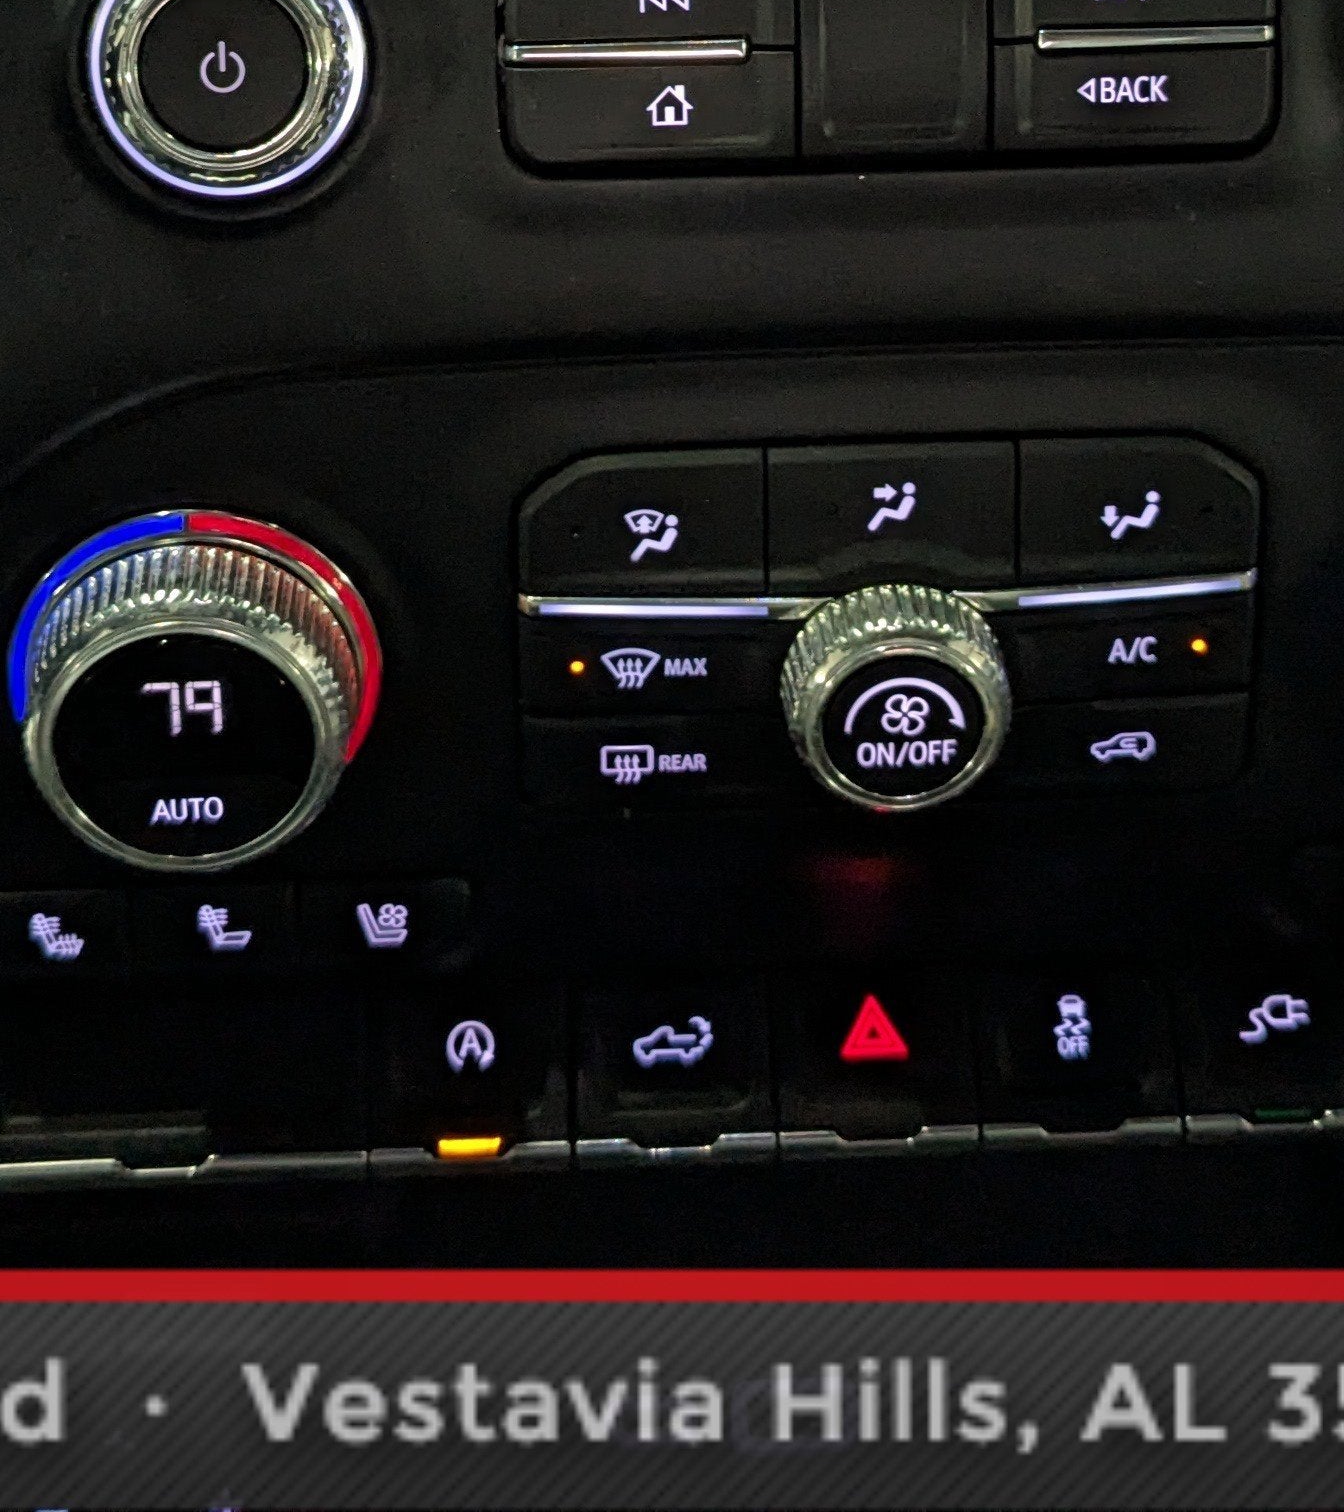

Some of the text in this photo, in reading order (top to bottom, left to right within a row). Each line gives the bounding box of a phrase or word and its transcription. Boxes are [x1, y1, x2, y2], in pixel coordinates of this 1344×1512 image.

[1098, 73, 1170, 105] BACK
[1106, 634, 1158, 664] A/C
[663, 655, 709, 678] MAX
[142, 679, 224, 736] 79
[657, 751, 709, 774] REAR
[855, 737, 958, 768] ON/OFF
[150, 795, 225, 825] AUTO
[1056, 1035, 1090, 1060] OFF
